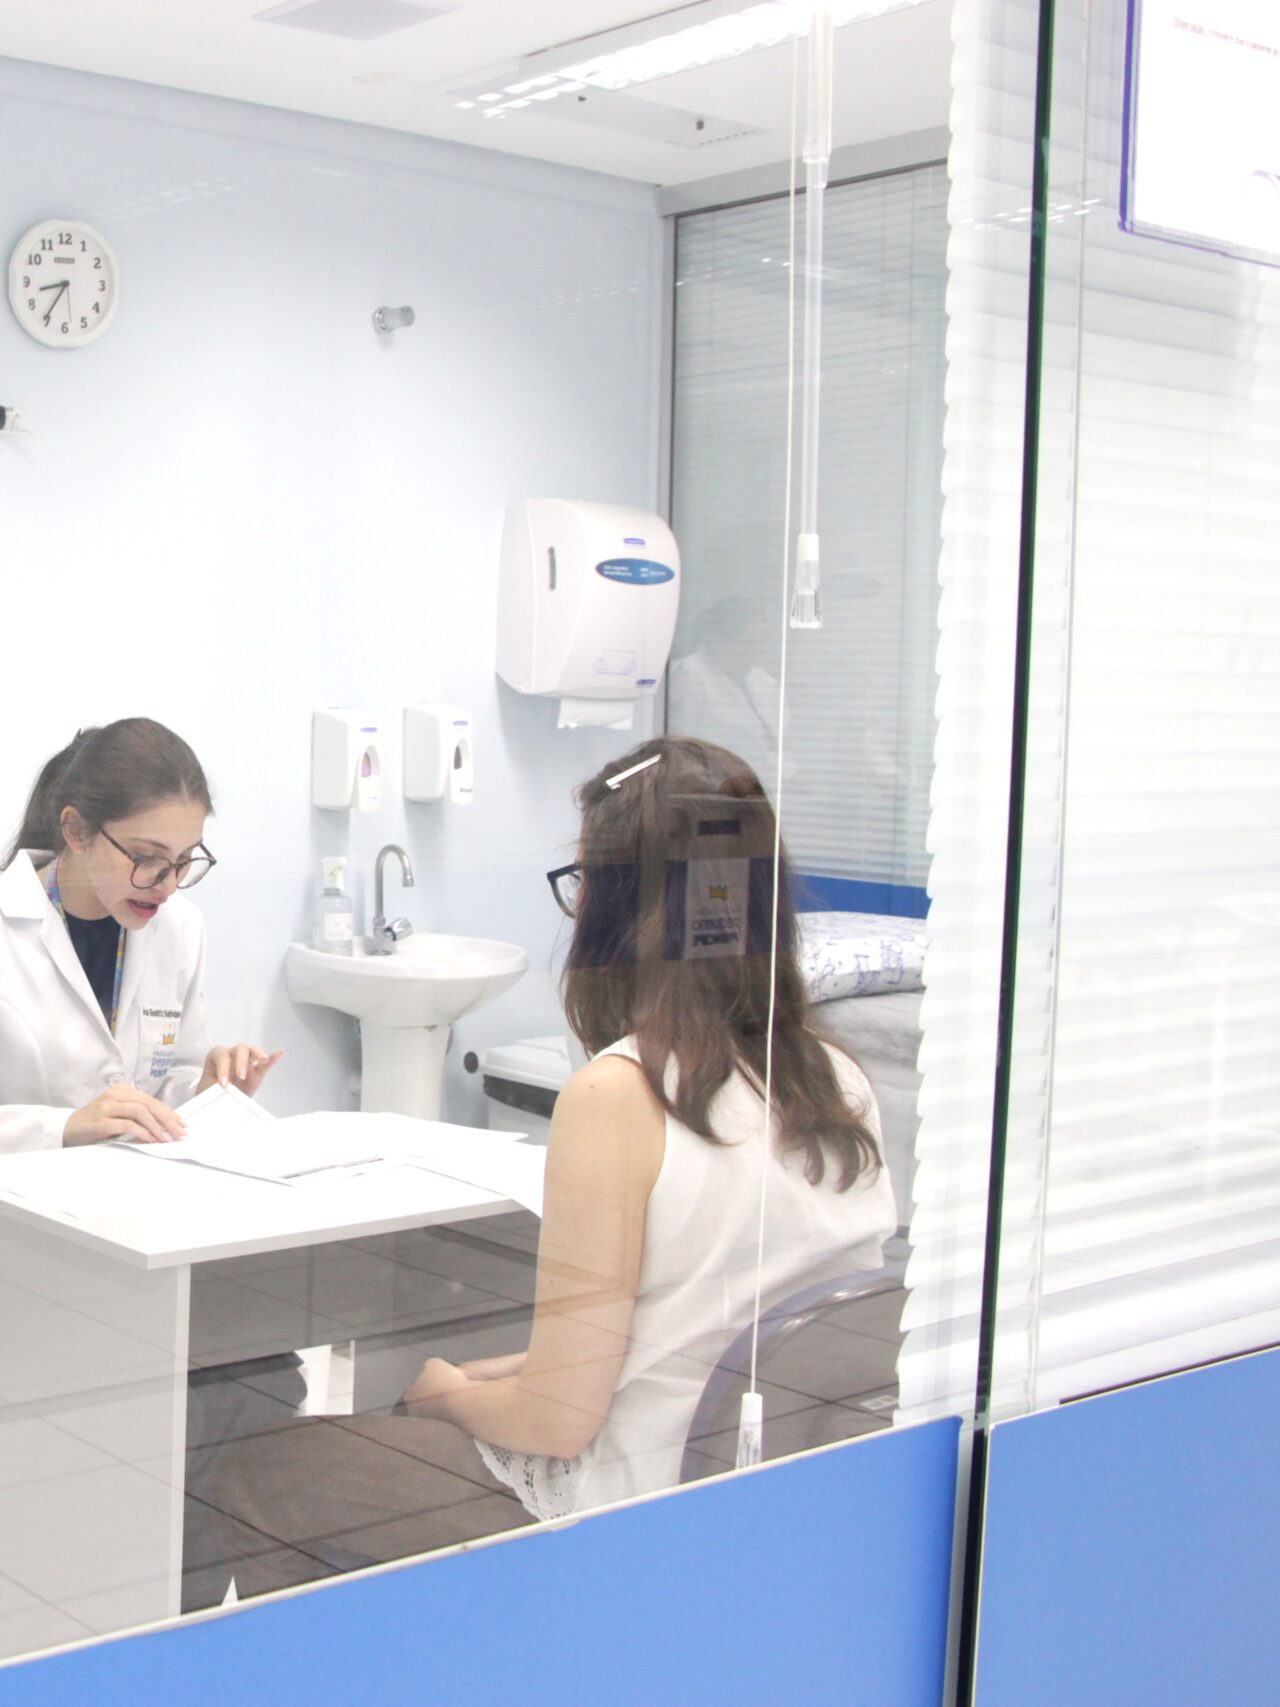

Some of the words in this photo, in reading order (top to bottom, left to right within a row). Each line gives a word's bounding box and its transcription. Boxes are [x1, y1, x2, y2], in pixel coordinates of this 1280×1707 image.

[40, 239, 53, 251] 11
[58, 233, 72, 245] 12
[80, 240, 87, 252] 1
[27, 254, 42, 265] 10
[93, 257, 102, 269] 2
[23, 276, 31, 288] 9
[98, 280, 106, 292] 3
[28, 298, 36, 310] 8
[92, 302, 100, 313] 4
[43, 315, 51, 327] 7
[80, 317, 88, 329] 5
[61, 322, 69, 334] 6
